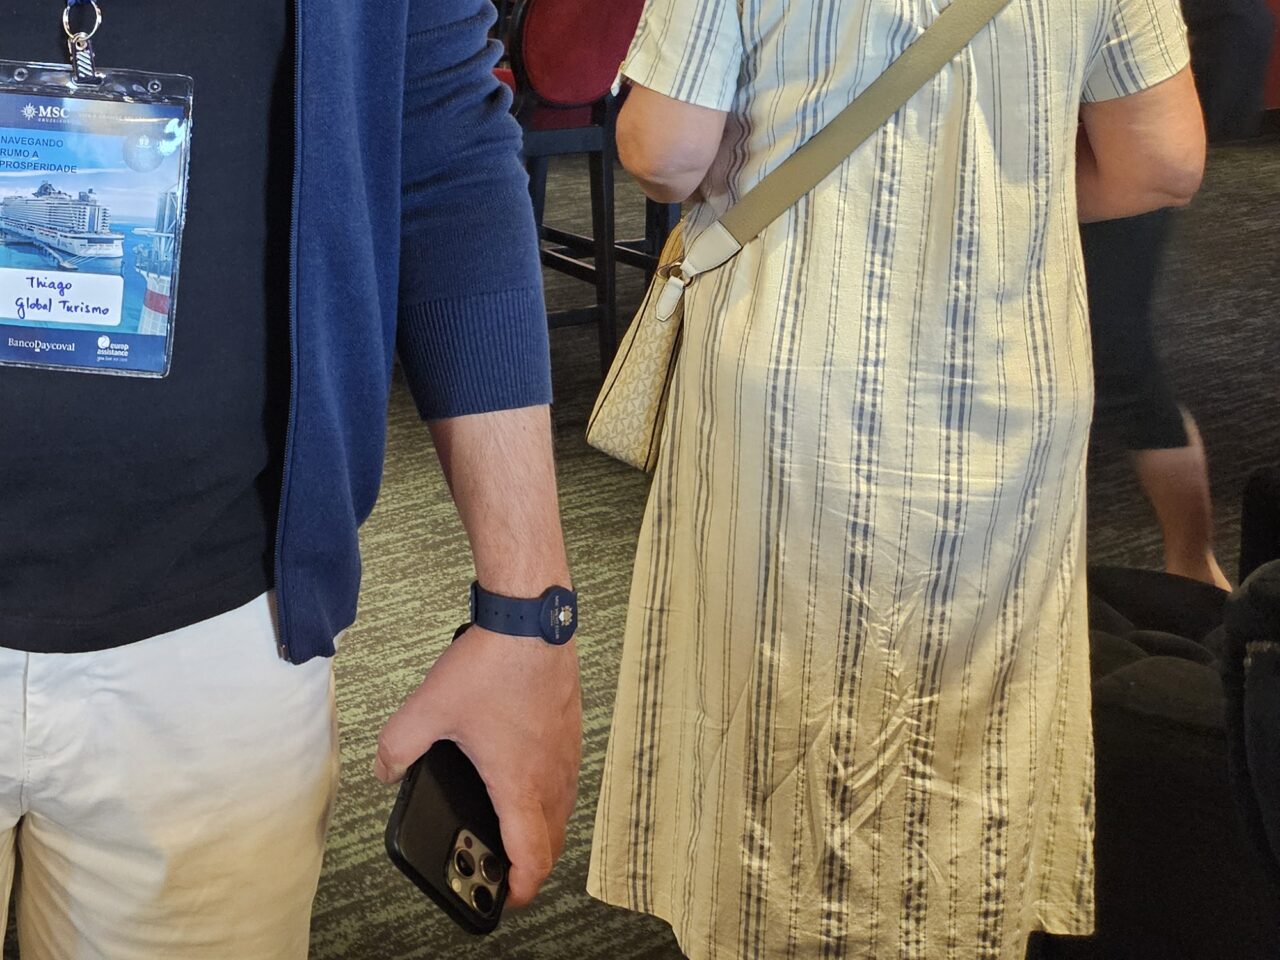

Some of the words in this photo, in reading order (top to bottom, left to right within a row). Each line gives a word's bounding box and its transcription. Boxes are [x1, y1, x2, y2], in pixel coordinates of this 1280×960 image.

[38, 105, 71, 119] MSC
[0, 135, 64, 148] NAVEGANDO
[0, 148, 30, 158] RUMO
[31, 150, 40, 158] A
[25, 276, 73, 297] Thiago
[15, 296, 53, 320] Global
[58, 299, 110, 316] Turismo
[96, 348, 129, 357] assistance
[110, 343, 129, 351] europ
